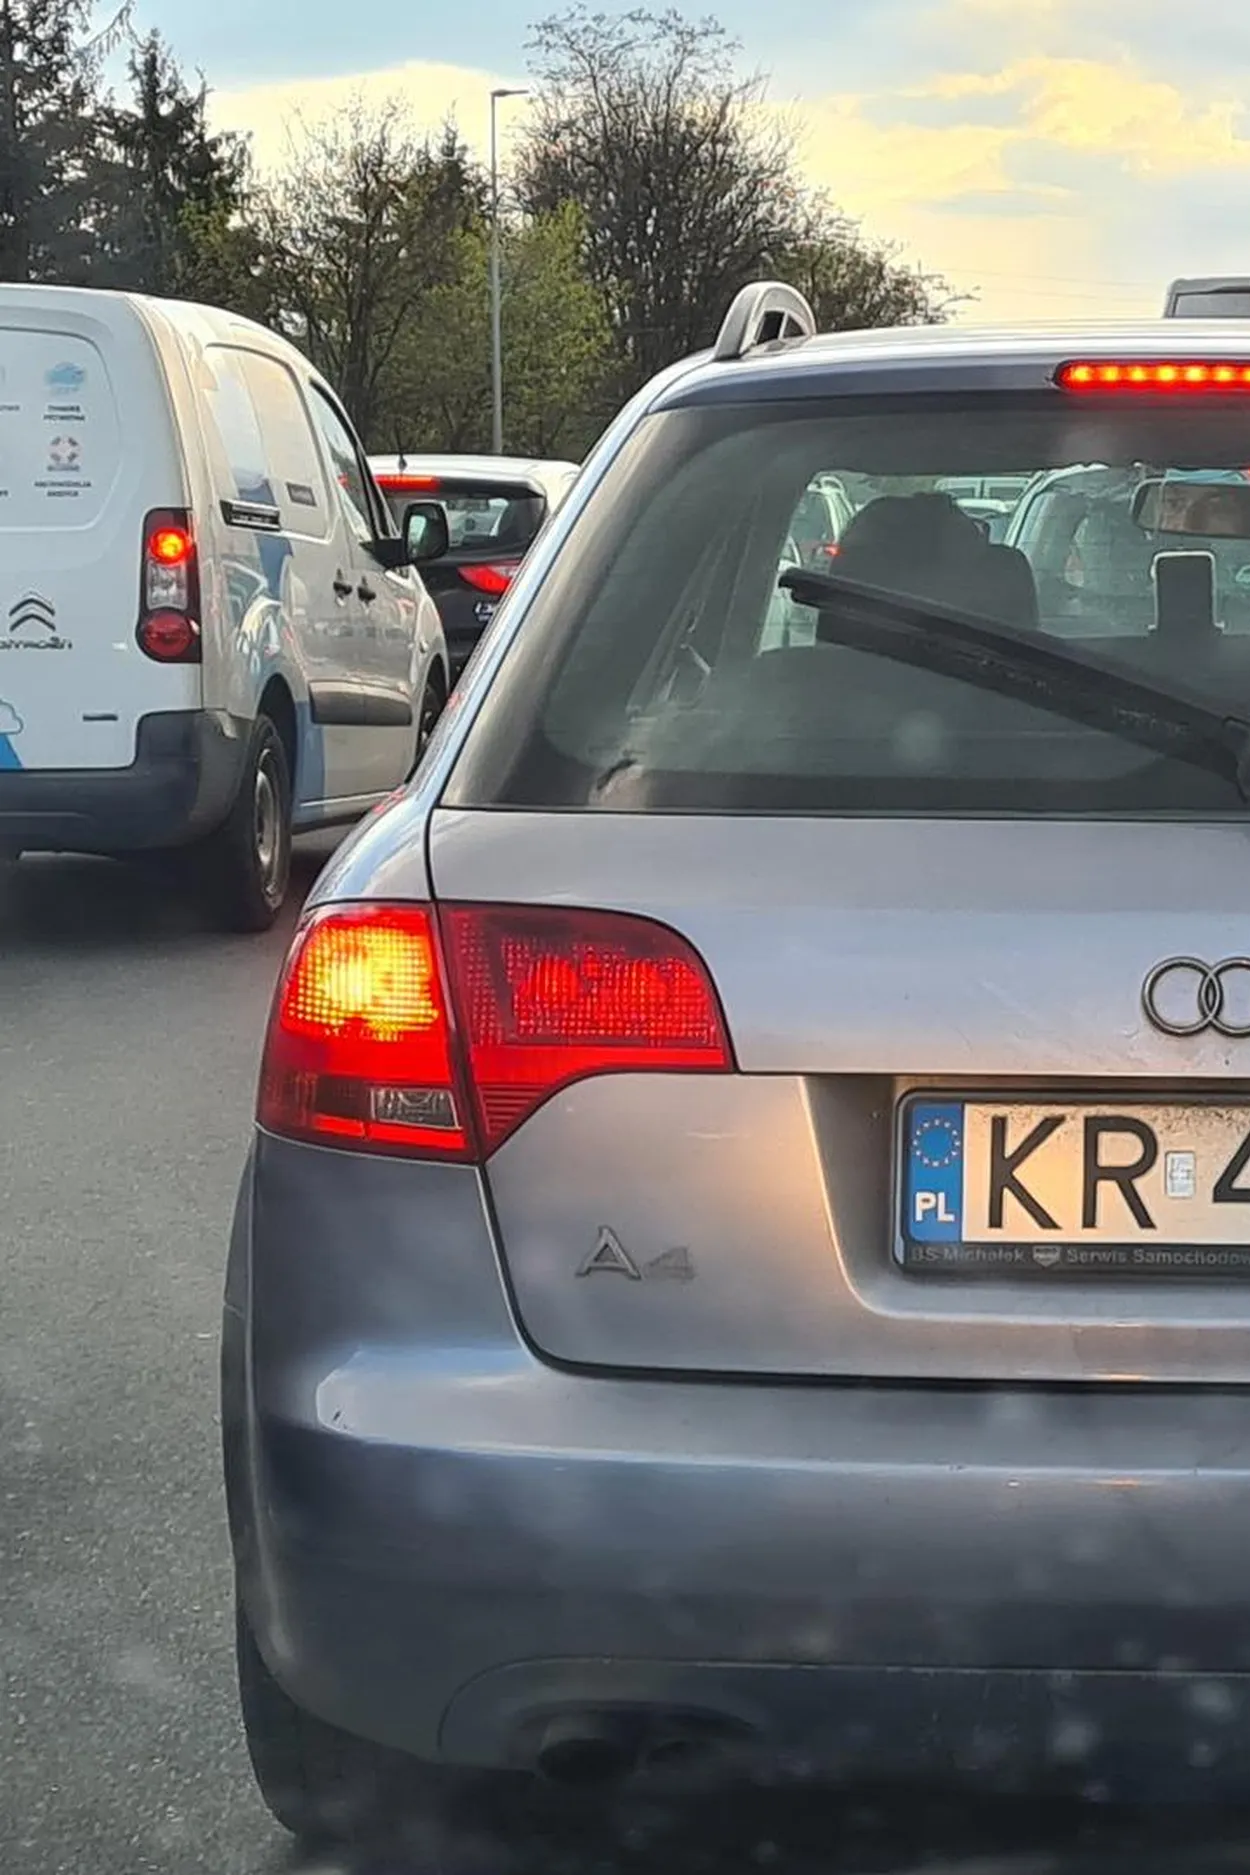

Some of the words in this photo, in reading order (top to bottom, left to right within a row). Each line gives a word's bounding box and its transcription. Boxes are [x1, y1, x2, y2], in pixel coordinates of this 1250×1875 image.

[988, 1115, 1157, 1230] KR
[914, 1191, 956, 1222] PL
[574, 1224, 697, 1280] A4
[1066, 1247, 1128, 1264] Serwis
